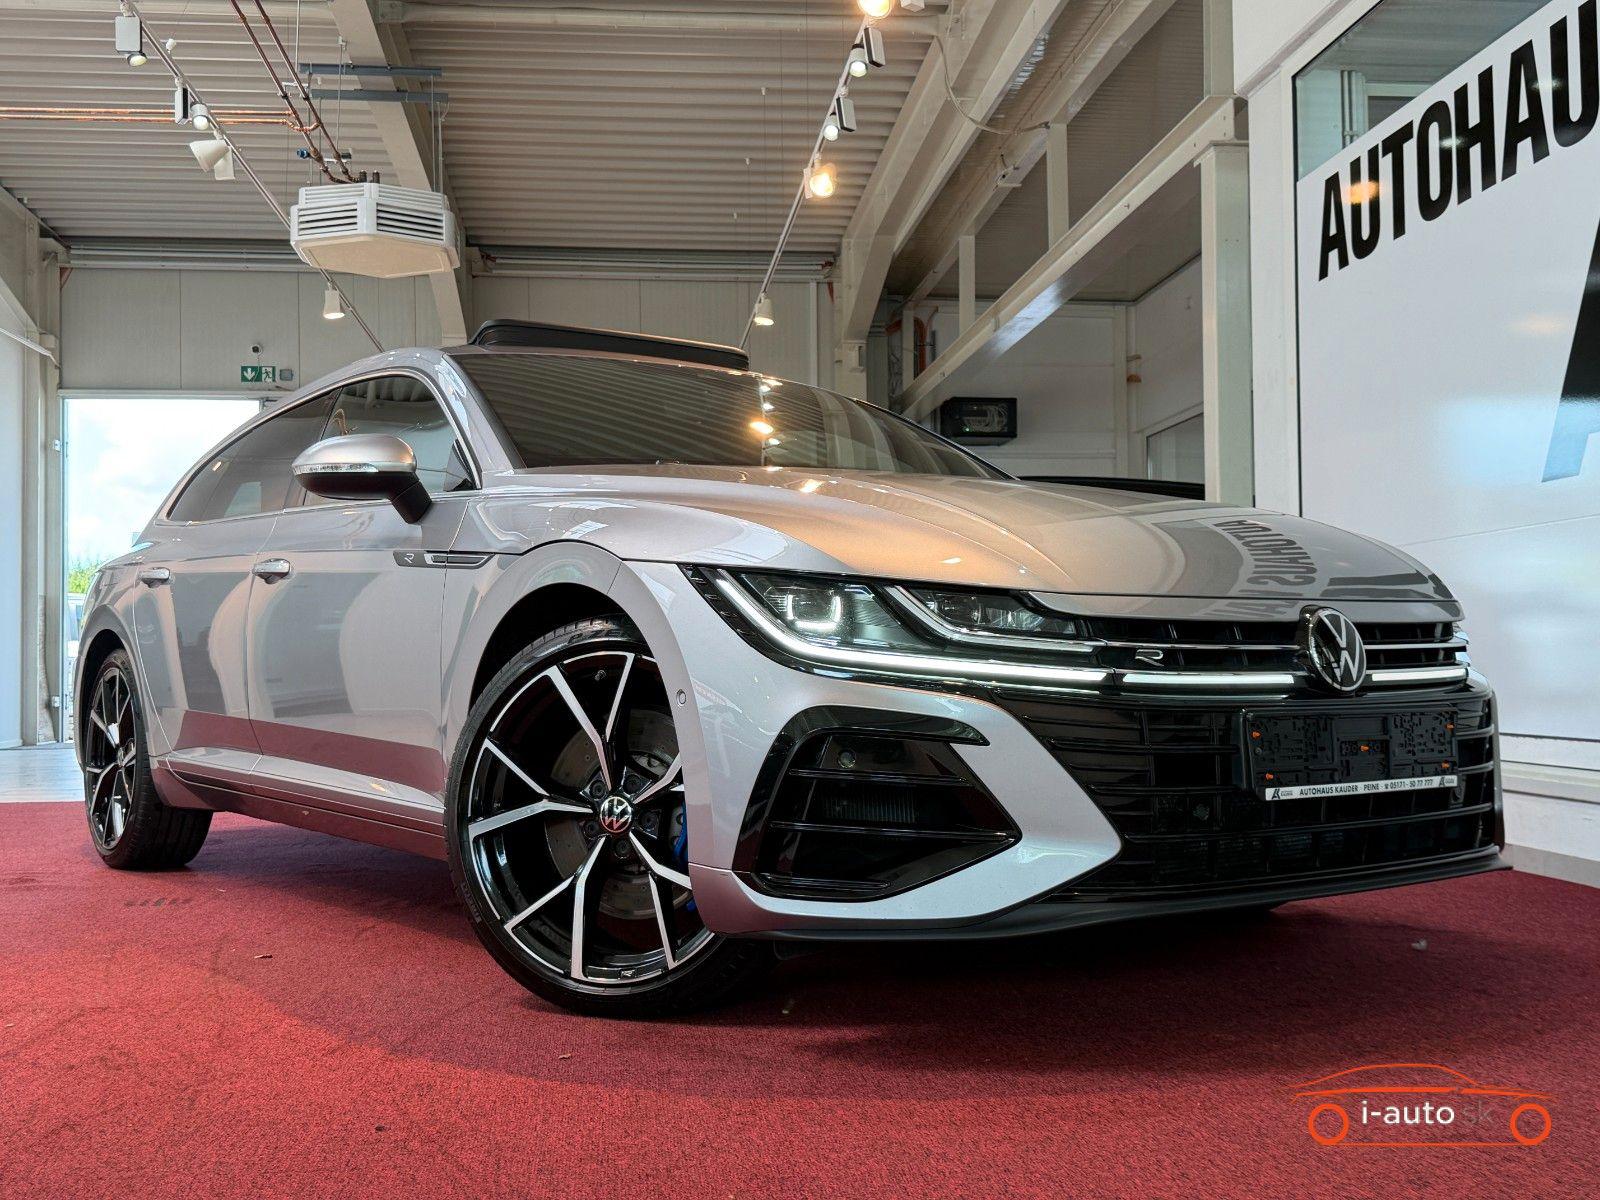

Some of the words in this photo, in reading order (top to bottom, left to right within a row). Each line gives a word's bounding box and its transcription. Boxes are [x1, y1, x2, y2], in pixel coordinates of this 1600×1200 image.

[1134, 648, 1165, 667] R
[1300, 786, 1334, 796] AUTOHAUS
[1334, 784, 1359, 793] KAUDER
[1363, 782, 1380, 791] PEINE
